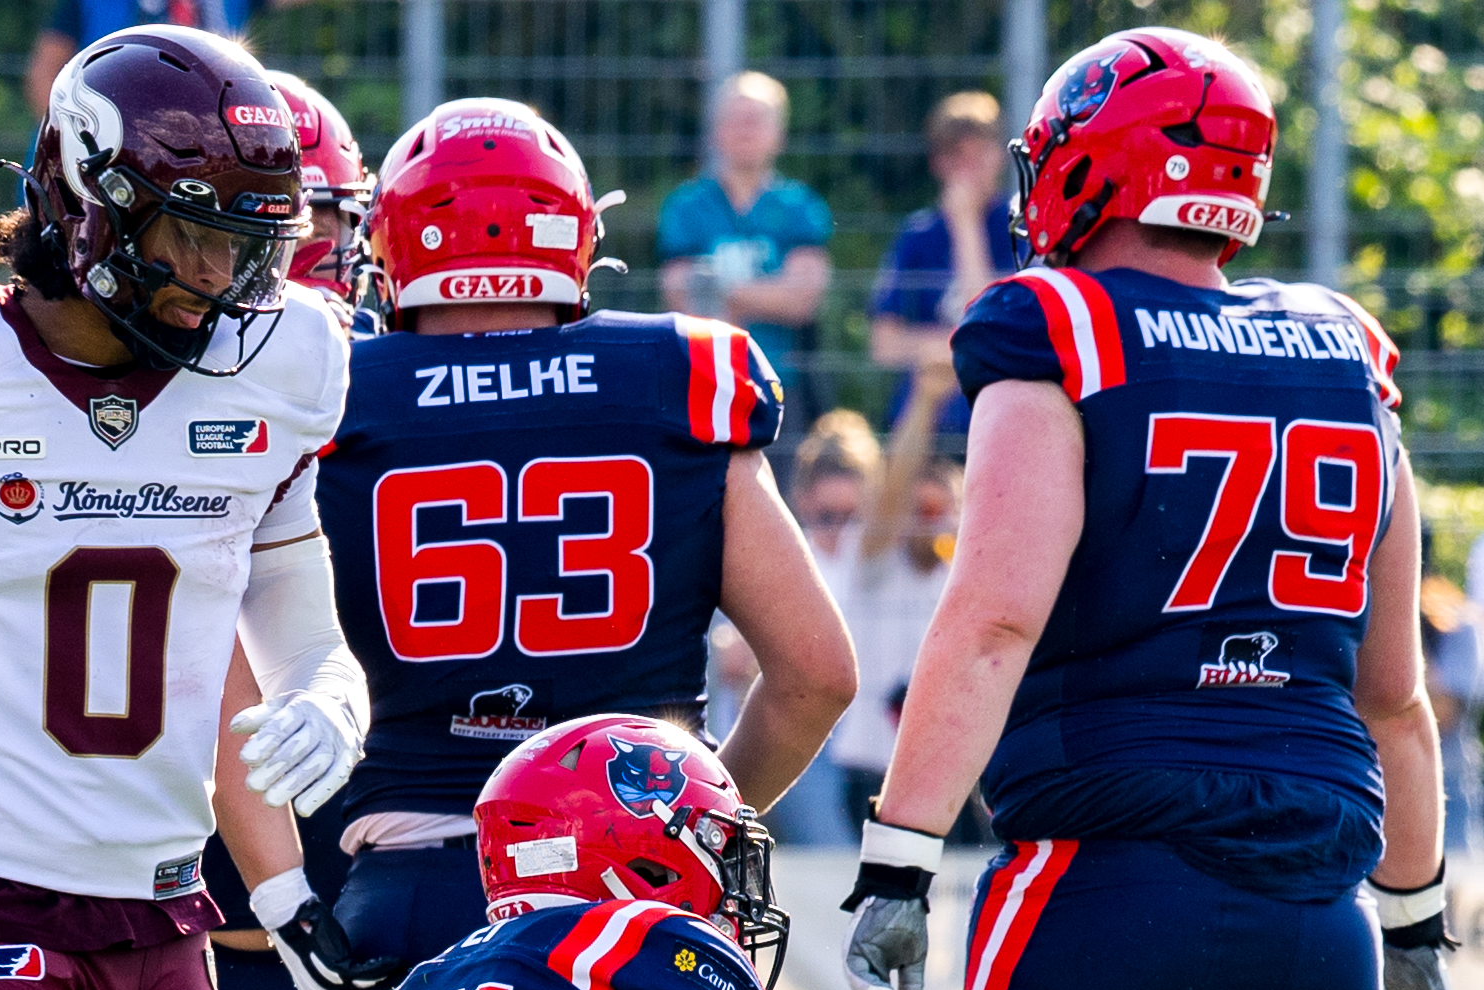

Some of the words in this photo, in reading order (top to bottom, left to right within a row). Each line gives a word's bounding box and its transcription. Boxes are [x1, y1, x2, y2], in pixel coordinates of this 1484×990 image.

[1169, 161, 1186, 174] 79
[1134, 308, 1369, 365] MUNDERLOH
[415, 354, 598, 407] ZIELKE
[196, 433, 224, 441] LEAGUE
[1145, 412, 1384, 617] 79
[373, 454, 654, 663] 63
[43, 545, 181, 759] 0
